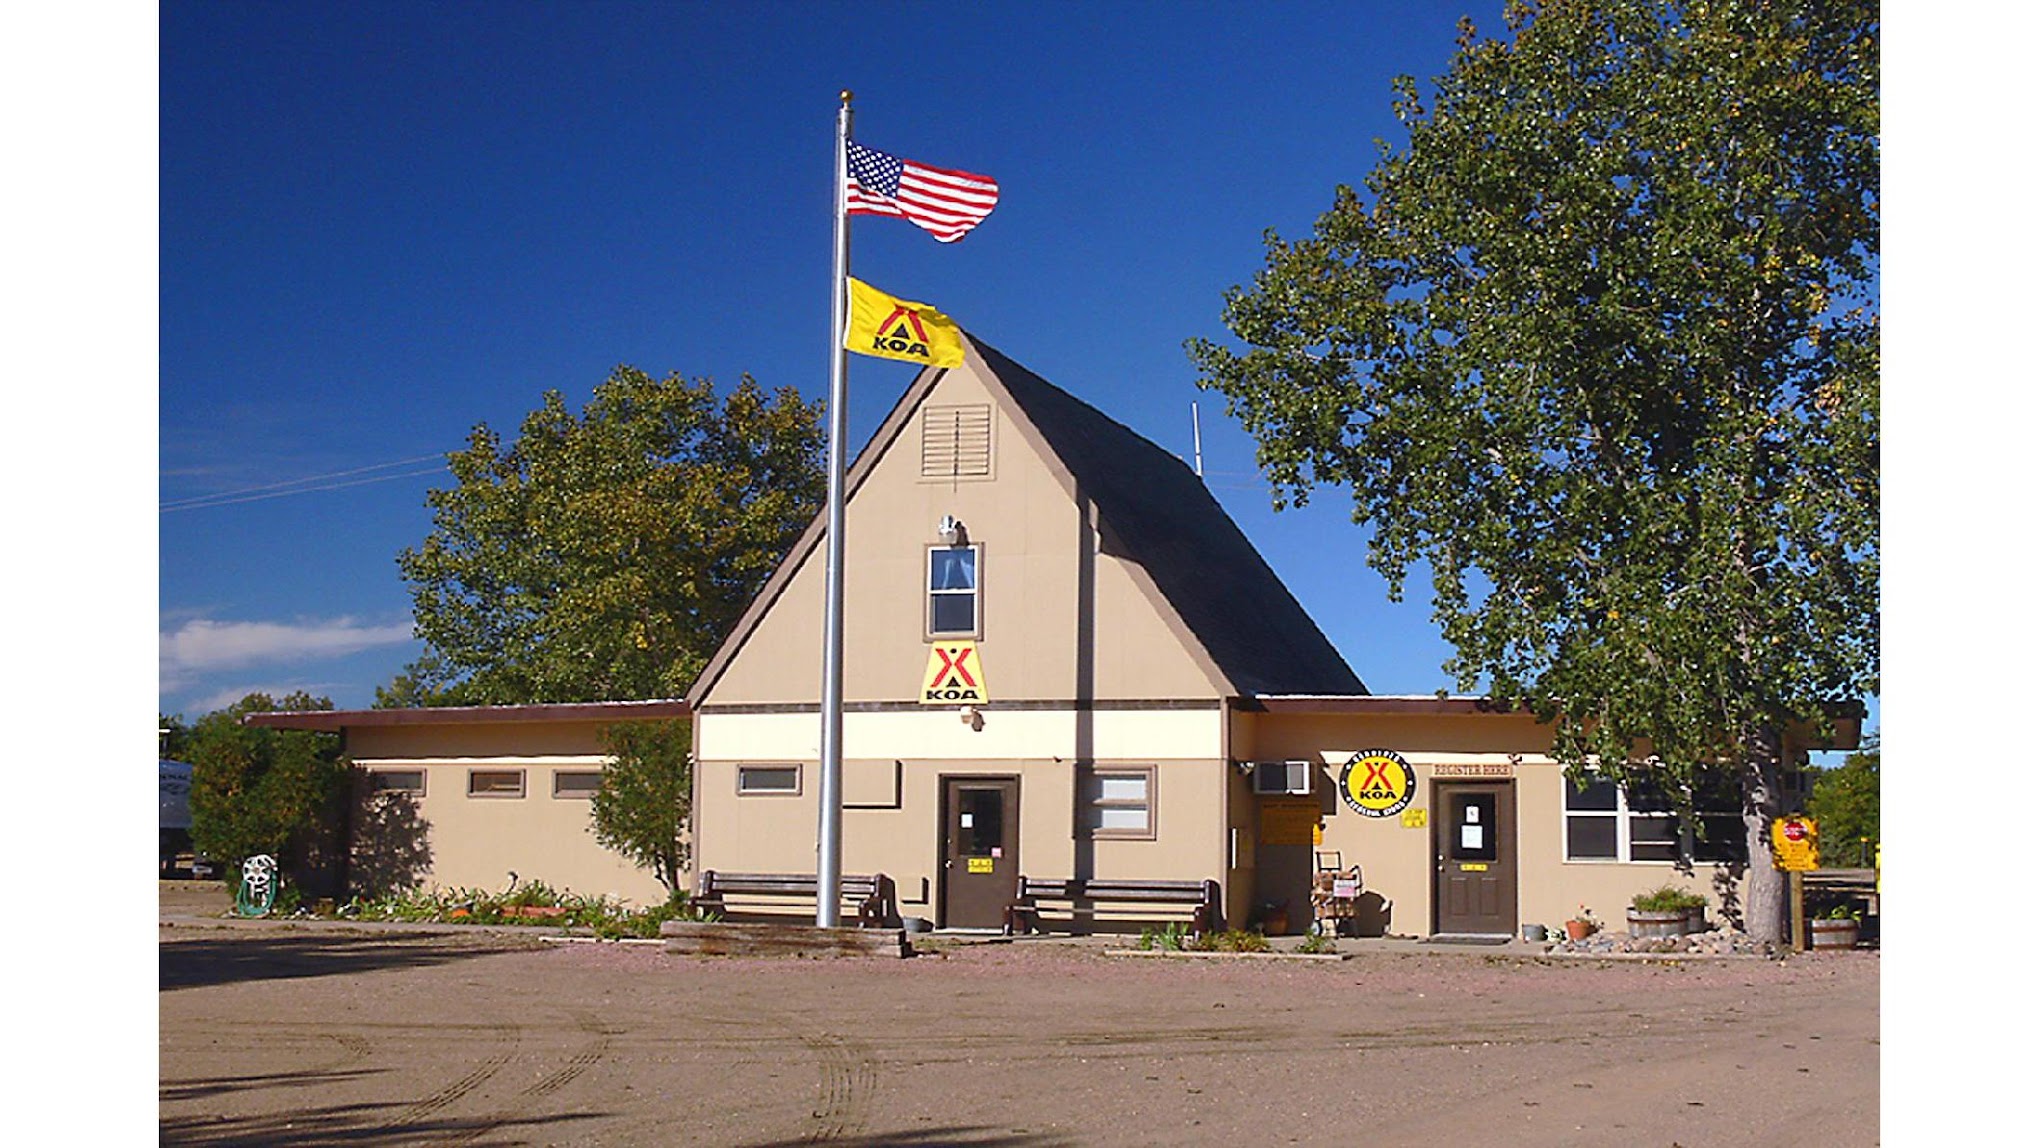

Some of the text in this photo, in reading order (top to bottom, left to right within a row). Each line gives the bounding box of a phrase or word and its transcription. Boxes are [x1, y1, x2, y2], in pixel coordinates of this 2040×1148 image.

[873, 336, 930, 357] KOA
[926, 690, 979, 700] KOA
[1360, 791, 1397, 799] KOA
